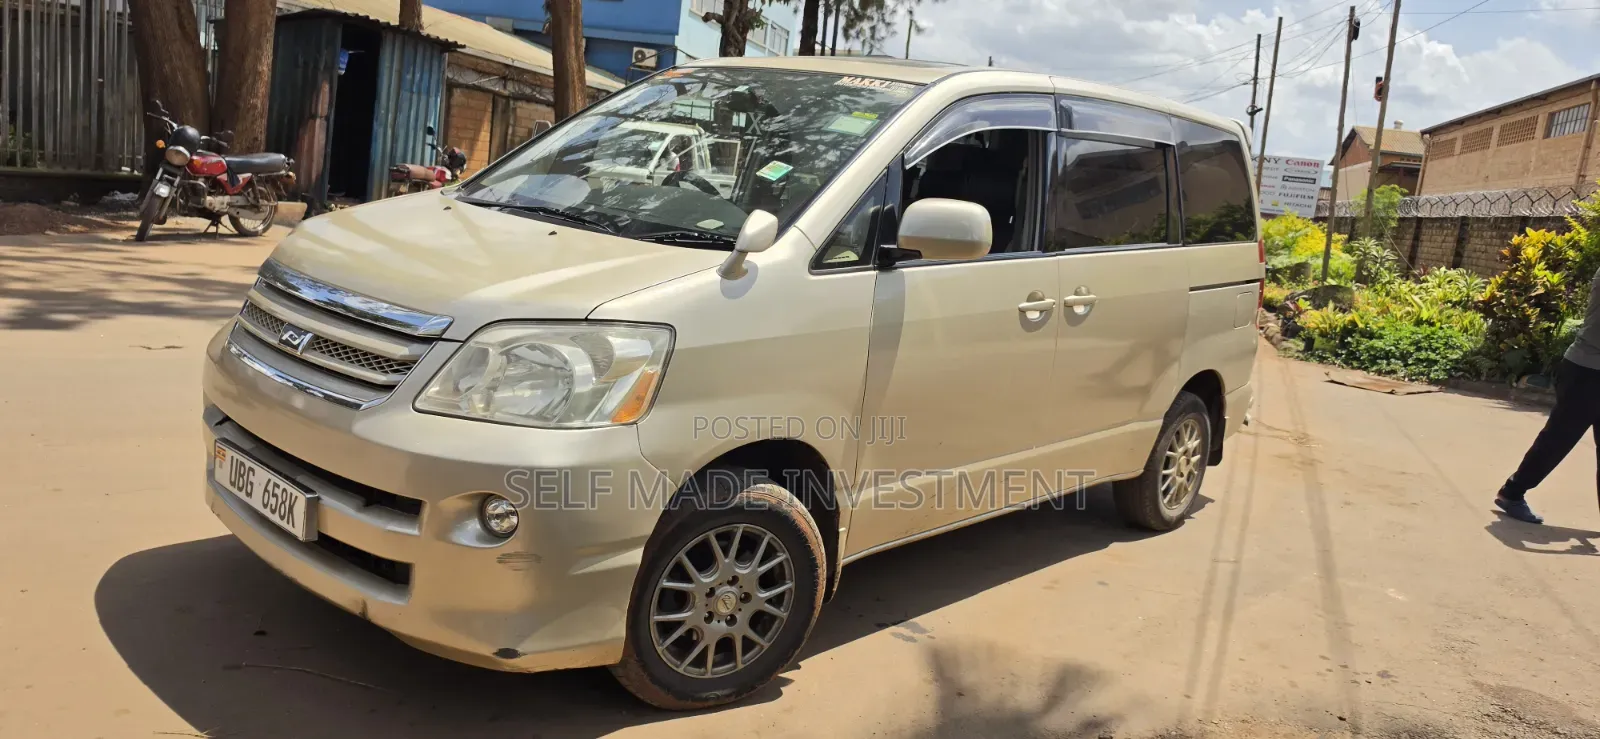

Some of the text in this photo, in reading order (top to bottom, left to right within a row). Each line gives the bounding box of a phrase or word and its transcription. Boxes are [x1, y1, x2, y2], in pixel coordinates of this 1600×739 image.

[1251, 156, 1281, 164] ONY
[1285, 159, 1320, 168] Canon
[1283, 176, 1315, 184] Panasonic
[1278, 192, 1314, 200] FUJIFILM
[229, 455, 298, 528] UBG 658K
